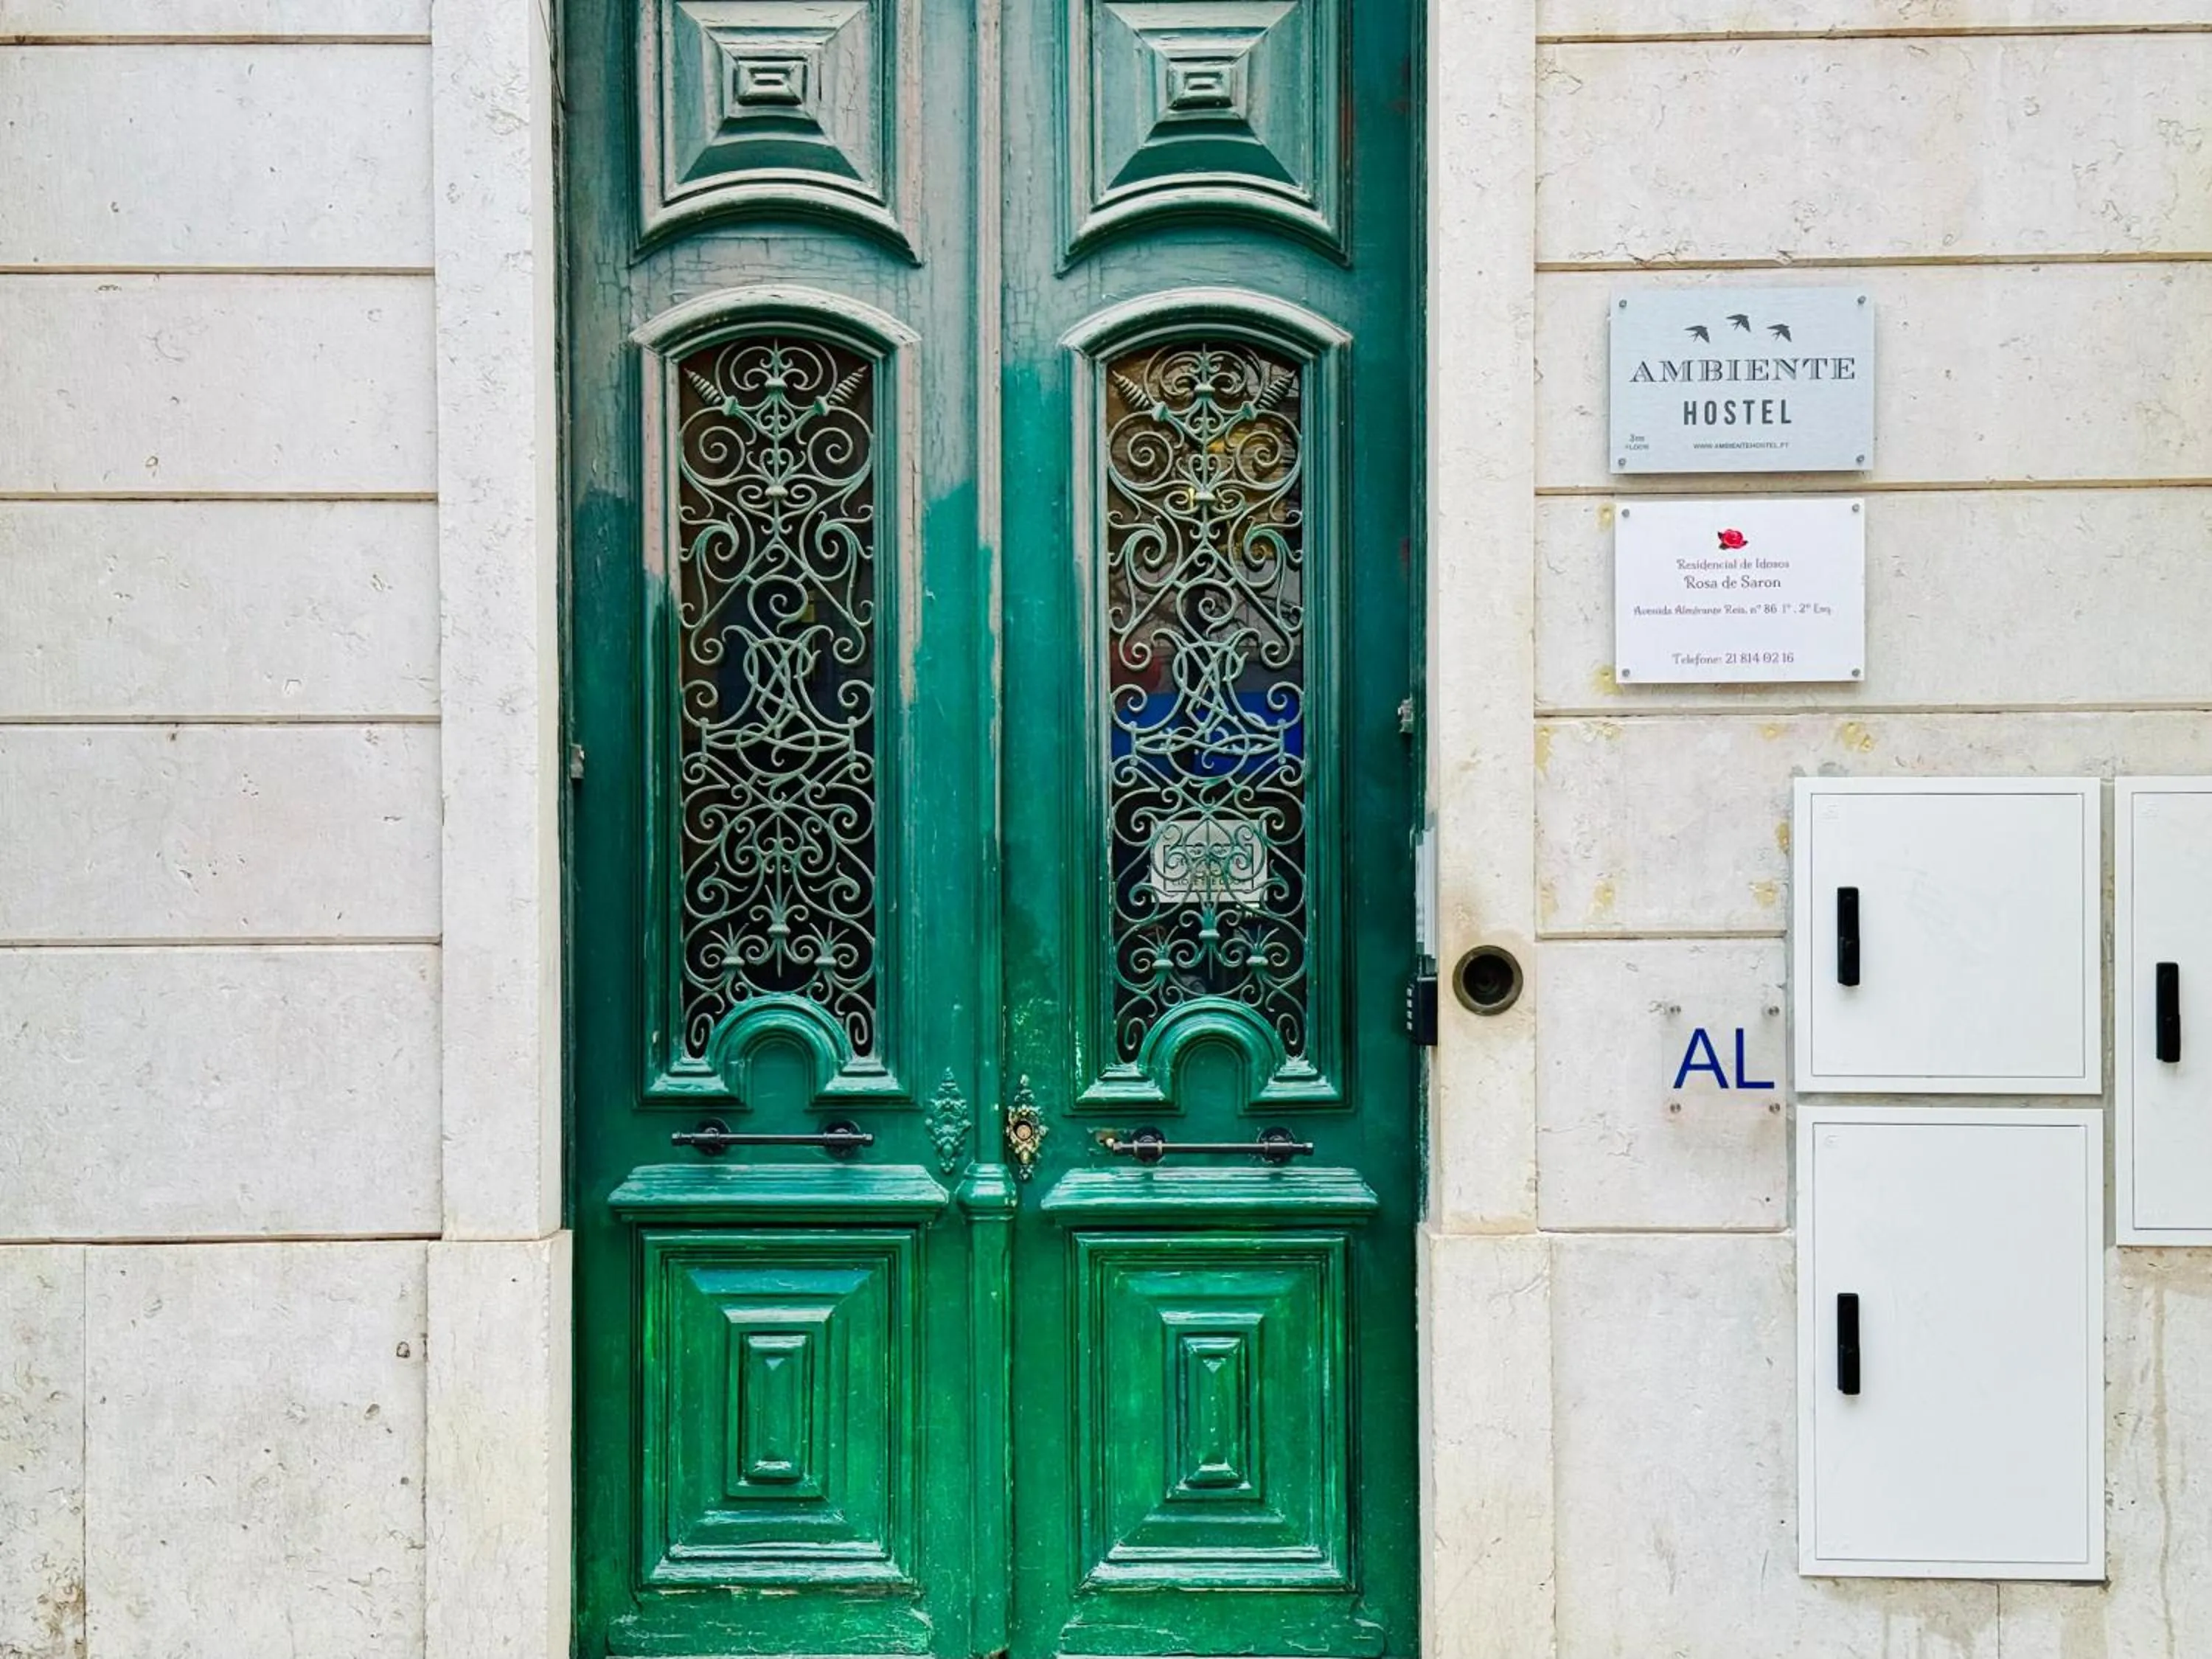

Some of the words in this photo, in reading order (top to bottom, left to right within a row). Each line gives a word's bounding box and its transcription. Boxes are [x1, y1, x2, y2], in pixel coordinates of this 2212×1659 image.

[1630, 357, 1855, 383] AMBIENTE
[1683, 399, 1792, 425] HOSTEL
[1676, 558, 1738, 571] Residencial
[1739, 558, 1753, 570] de
[1755, 557, 1790, 570] Idosos
[1683, 574, 1718, 589] Rosa
[1721, 575, 1738, 590] de
[1741, 574, 1781, 589] Saron
[1725, 652, 1737, 664] 21
[1739, 652, 1760, 664] 814
[1672, 1027, 1775, 1090] AL
